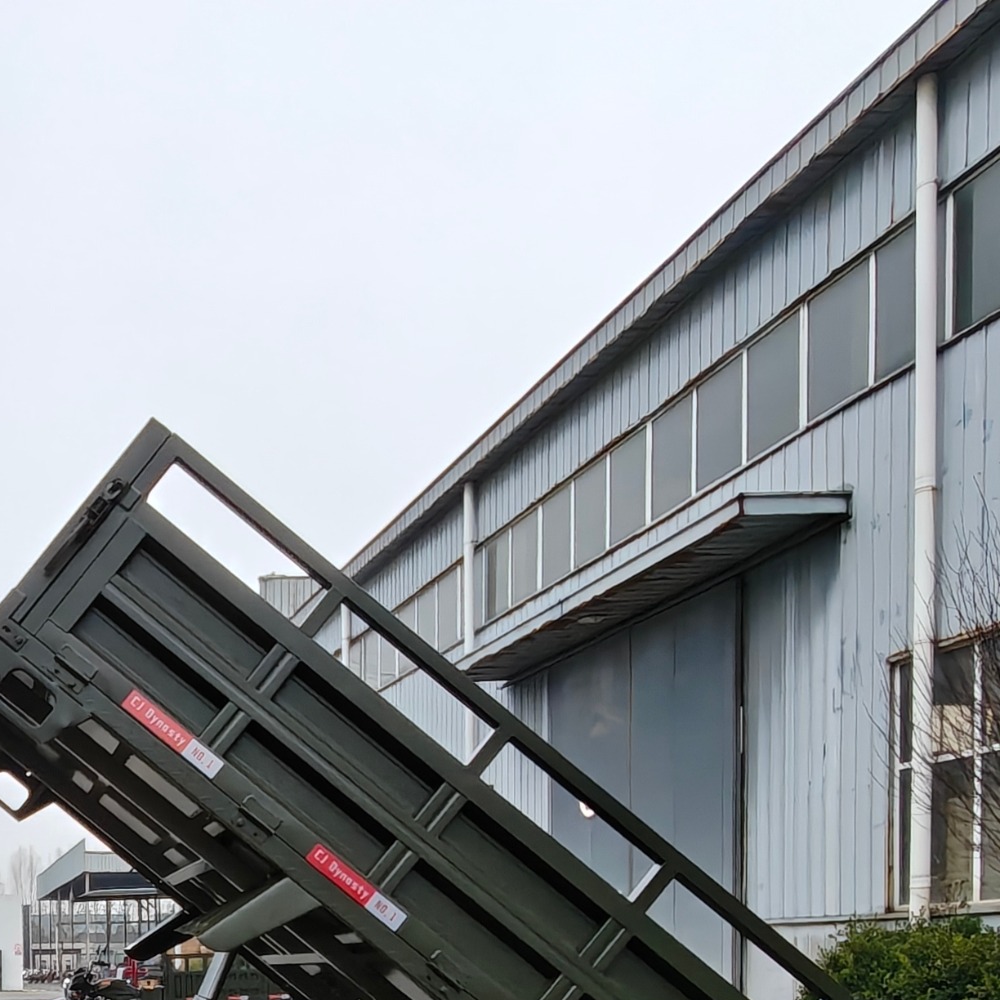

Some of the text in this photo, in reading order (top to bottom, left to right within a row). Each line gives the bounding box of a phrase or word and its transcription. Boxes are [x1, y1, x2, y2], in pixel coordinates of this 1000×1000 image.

[144, 707, 187, 747] Dynasty
[313, 848, 329, 864] CJ
[328, 860, 370, 900] Dynasty
